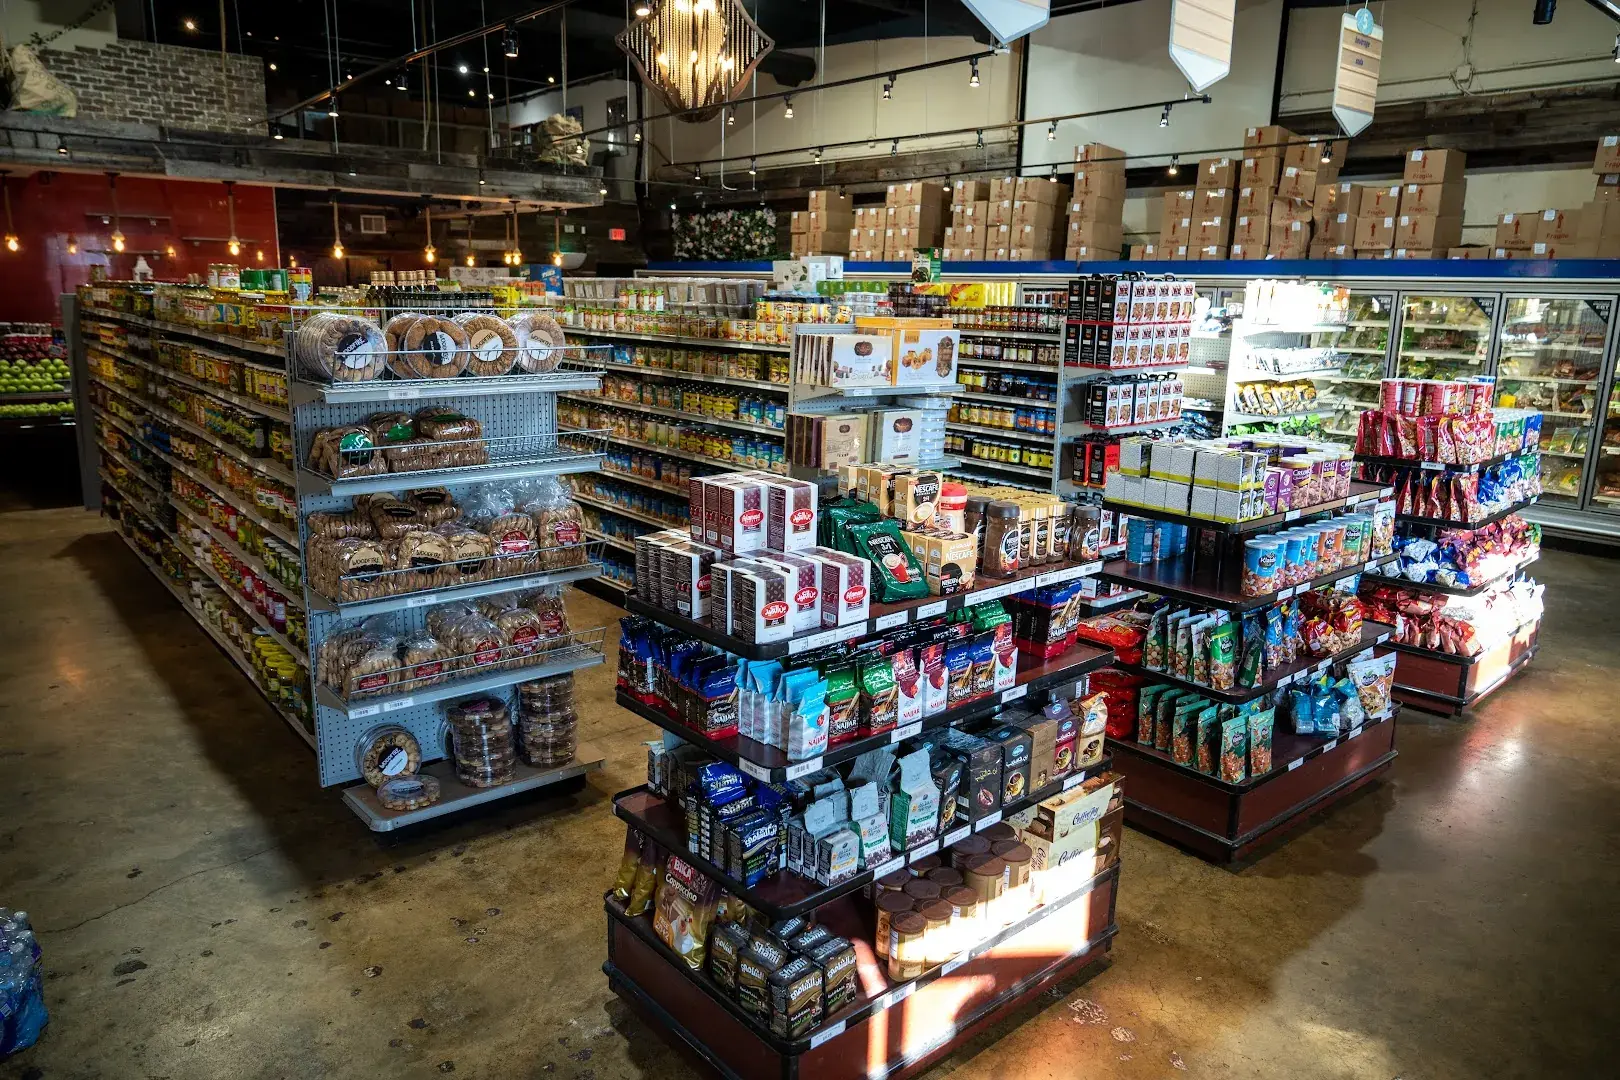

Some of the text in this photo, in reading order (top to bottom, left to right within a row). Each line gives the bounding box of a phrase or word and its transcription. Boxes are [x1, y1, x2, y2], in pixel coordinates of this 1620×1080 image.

[836, 719, 858, 730] NAJJAR
[799, 927, 827, 947] Shami
[753, 940, 782, 966] Shami
